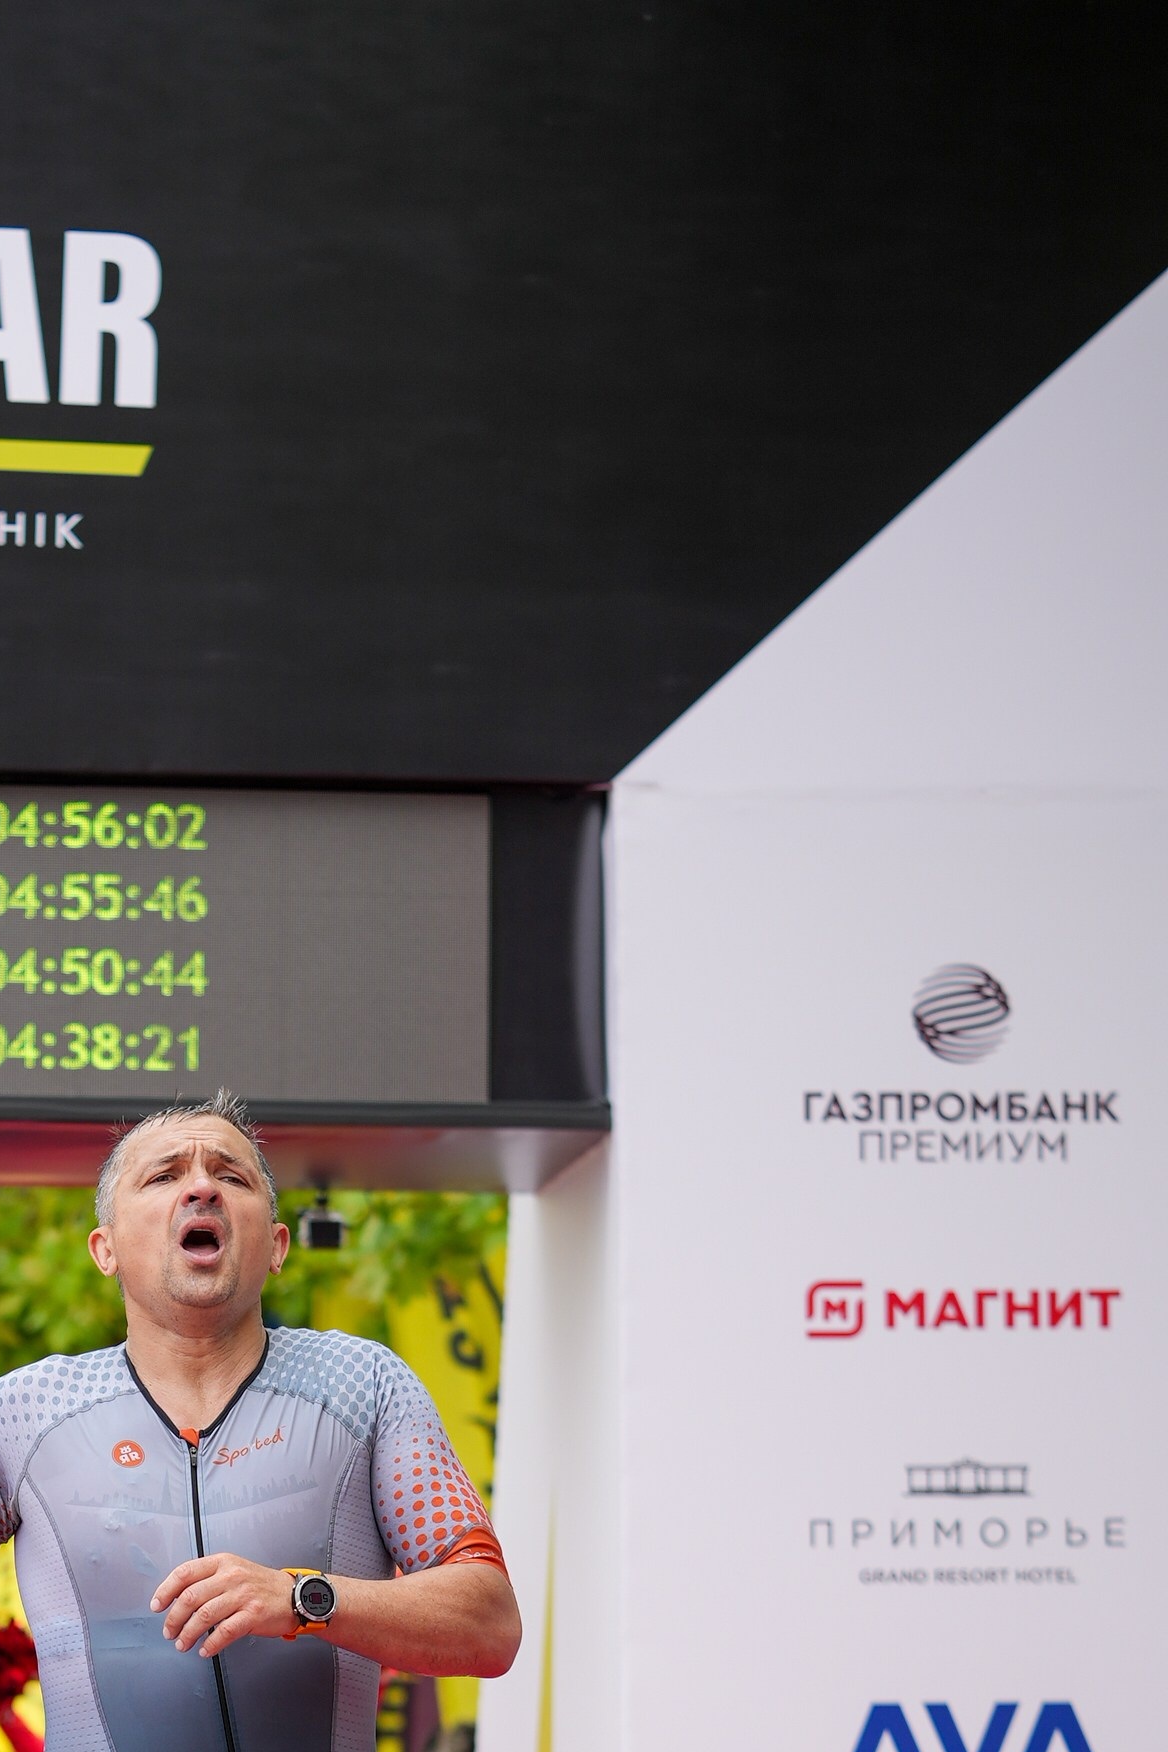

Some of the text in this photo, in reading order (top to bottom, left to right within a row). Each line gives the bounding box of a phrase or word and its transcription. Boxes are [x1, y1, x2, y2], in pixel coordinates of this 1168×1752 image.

[803, 1091, 1120, 1125] ГАЗПРОМБАНК
[858, 1130, 1069, 1164] ПРЕМИУМ
[885, 1288, 1121, 1329] МАГНИТ
[808, 1515, 1127, 1550] ПРИМОРЬЕ
[858, 1567, 1077, 1586] GRAND RESORT HOTEL
